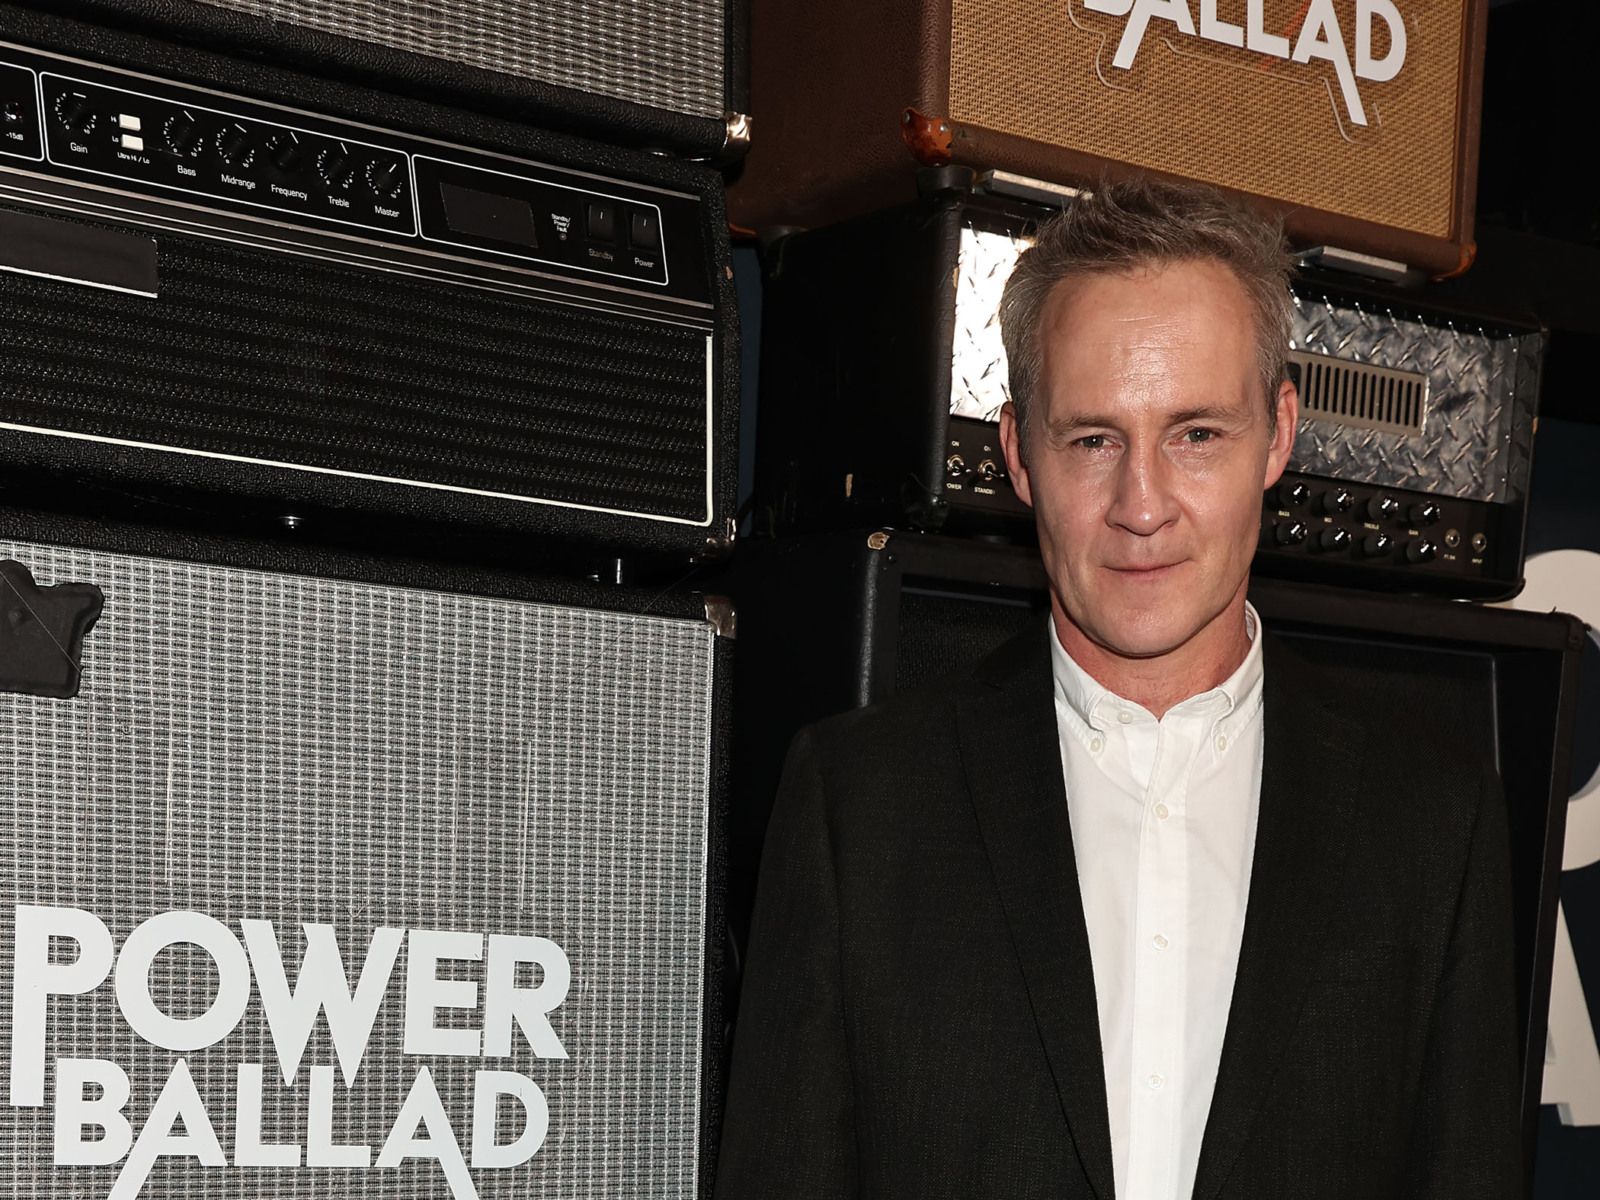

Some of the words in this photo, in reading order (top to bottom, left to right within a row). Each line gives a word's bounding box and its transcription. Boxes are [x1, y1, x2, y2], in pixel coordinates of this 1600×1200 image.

[1083, 0, 1407, 126] ALLAD
[70, 142, 88, 154] Gain
[177, 164, 196, 176] Bass
[221, 173, 256, 190] Midrange
[271, 184, 308, 201] Frequency
[328, 195, 350, 208] Treble
[374, 205, 400, 218] Master
[634, 257, 655, 268] Power
[10, 904, 571, 1107] POWER
